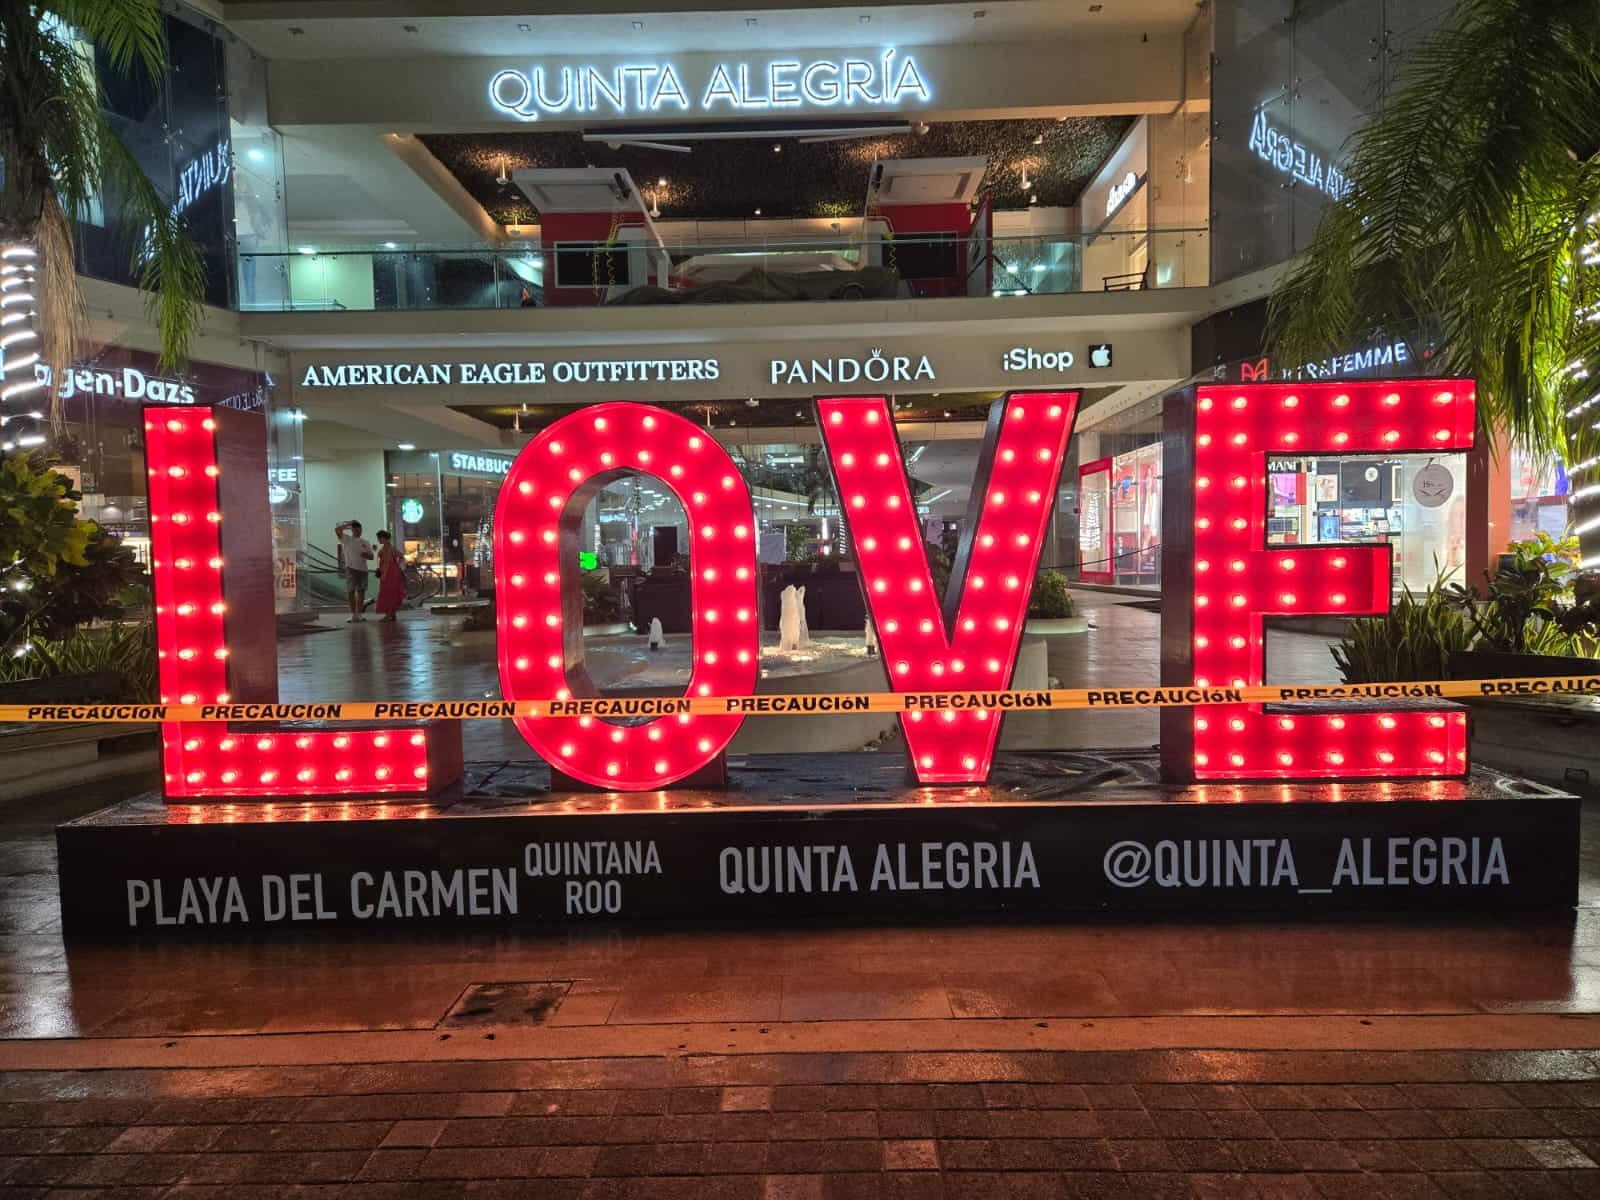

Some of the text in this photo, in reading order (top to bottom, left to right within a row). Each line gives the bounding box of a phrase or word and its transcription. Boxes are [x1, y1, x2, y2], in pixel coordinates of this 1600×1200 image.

[488, 47, 931, 121] QUINTA ALEGRÍA
[0, 351, 196, 404] agen-Dazs
[302, 358, 719, 387] AMERICAN EAGLE OUTFITTERS
[770, 347, 936, 385] PANDORA
[1003, 346, 1074, 372] iShop
[268, 468, 297, 482] FEE
[451, 452, 512, 474] STARBUC
[1268, 461, 1297, 471] MANI
[144, 378, 1476, 799] LOVE
[523, 840, 663, 878] QUINTANA
[719, 840, 1041, 896] QUINTA ALEGRIA
[127, 866, 519, 927] PLAYA DEL CARMEN
[565, 880, 622, 915] ROO
